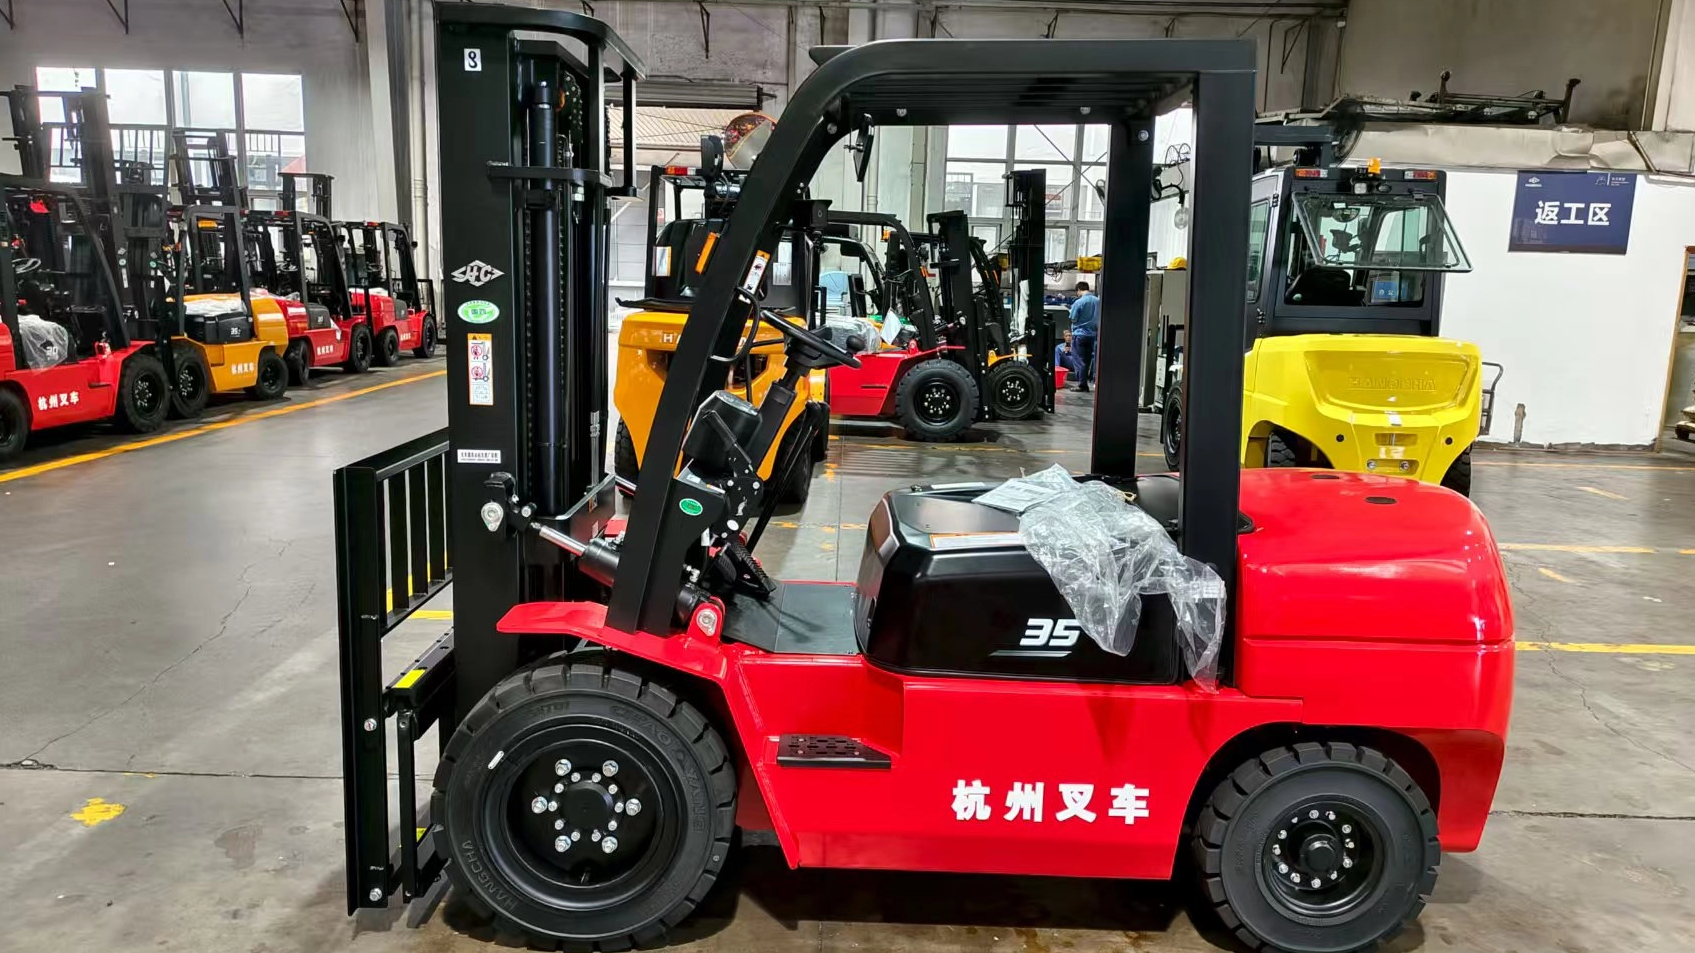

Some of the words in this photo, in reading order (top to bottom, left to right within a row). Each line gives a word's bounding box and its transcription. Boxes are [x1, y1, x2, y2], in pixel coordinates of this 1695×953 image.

[1534, 200, 1612, 226] 返工区
[37, 390, 80, 411] 杭州叉车
[1019, 618, 1082, 647] 35
[951, 778, 1151, 825] 杭州叉车
